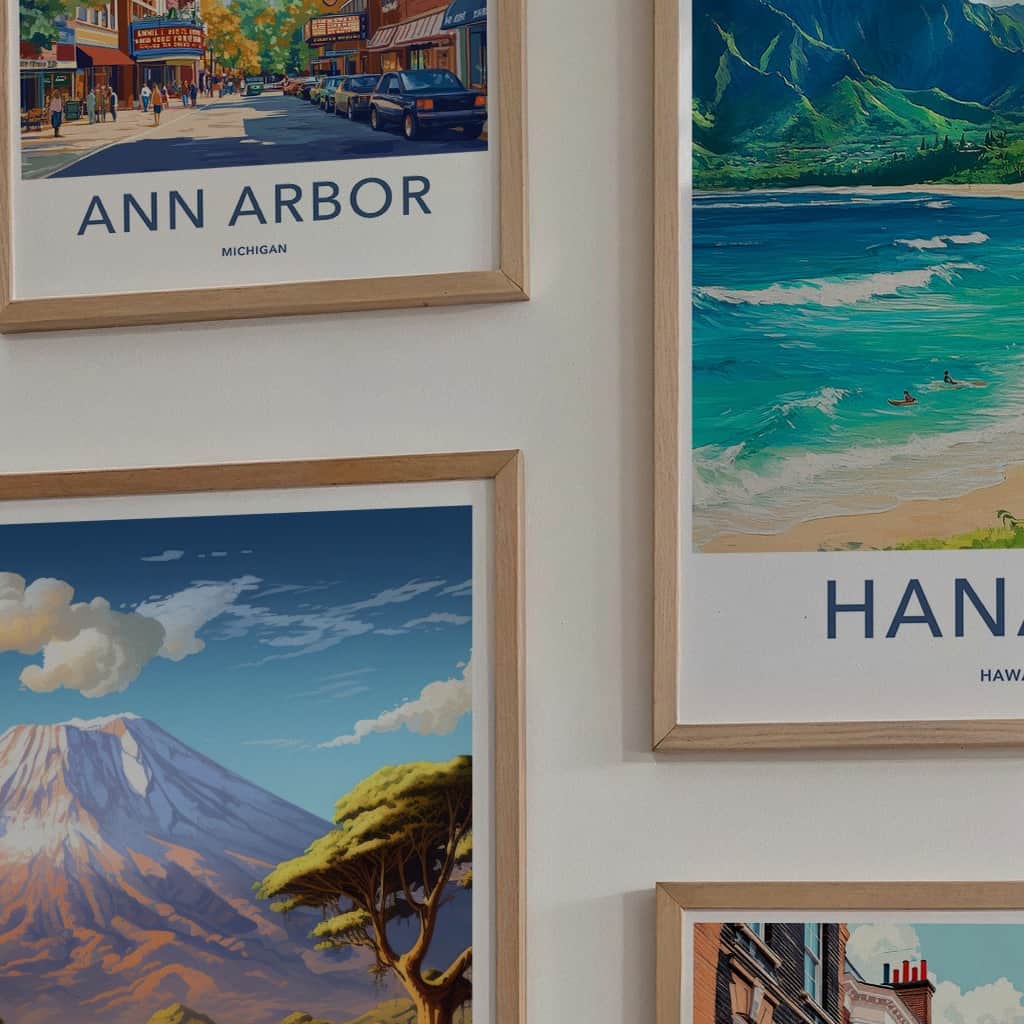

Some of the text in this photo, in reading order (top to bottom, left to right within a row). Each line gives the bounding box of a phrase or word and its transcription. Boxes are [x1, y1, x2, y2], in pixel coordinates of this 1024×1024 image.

[77, 175, 432, 236] ANN ARBOR
[221, 243, 288, 257] MICHIGAN
[826, 577, 1024, 640] HAN
[980, 669, 1024, 682] HAW
